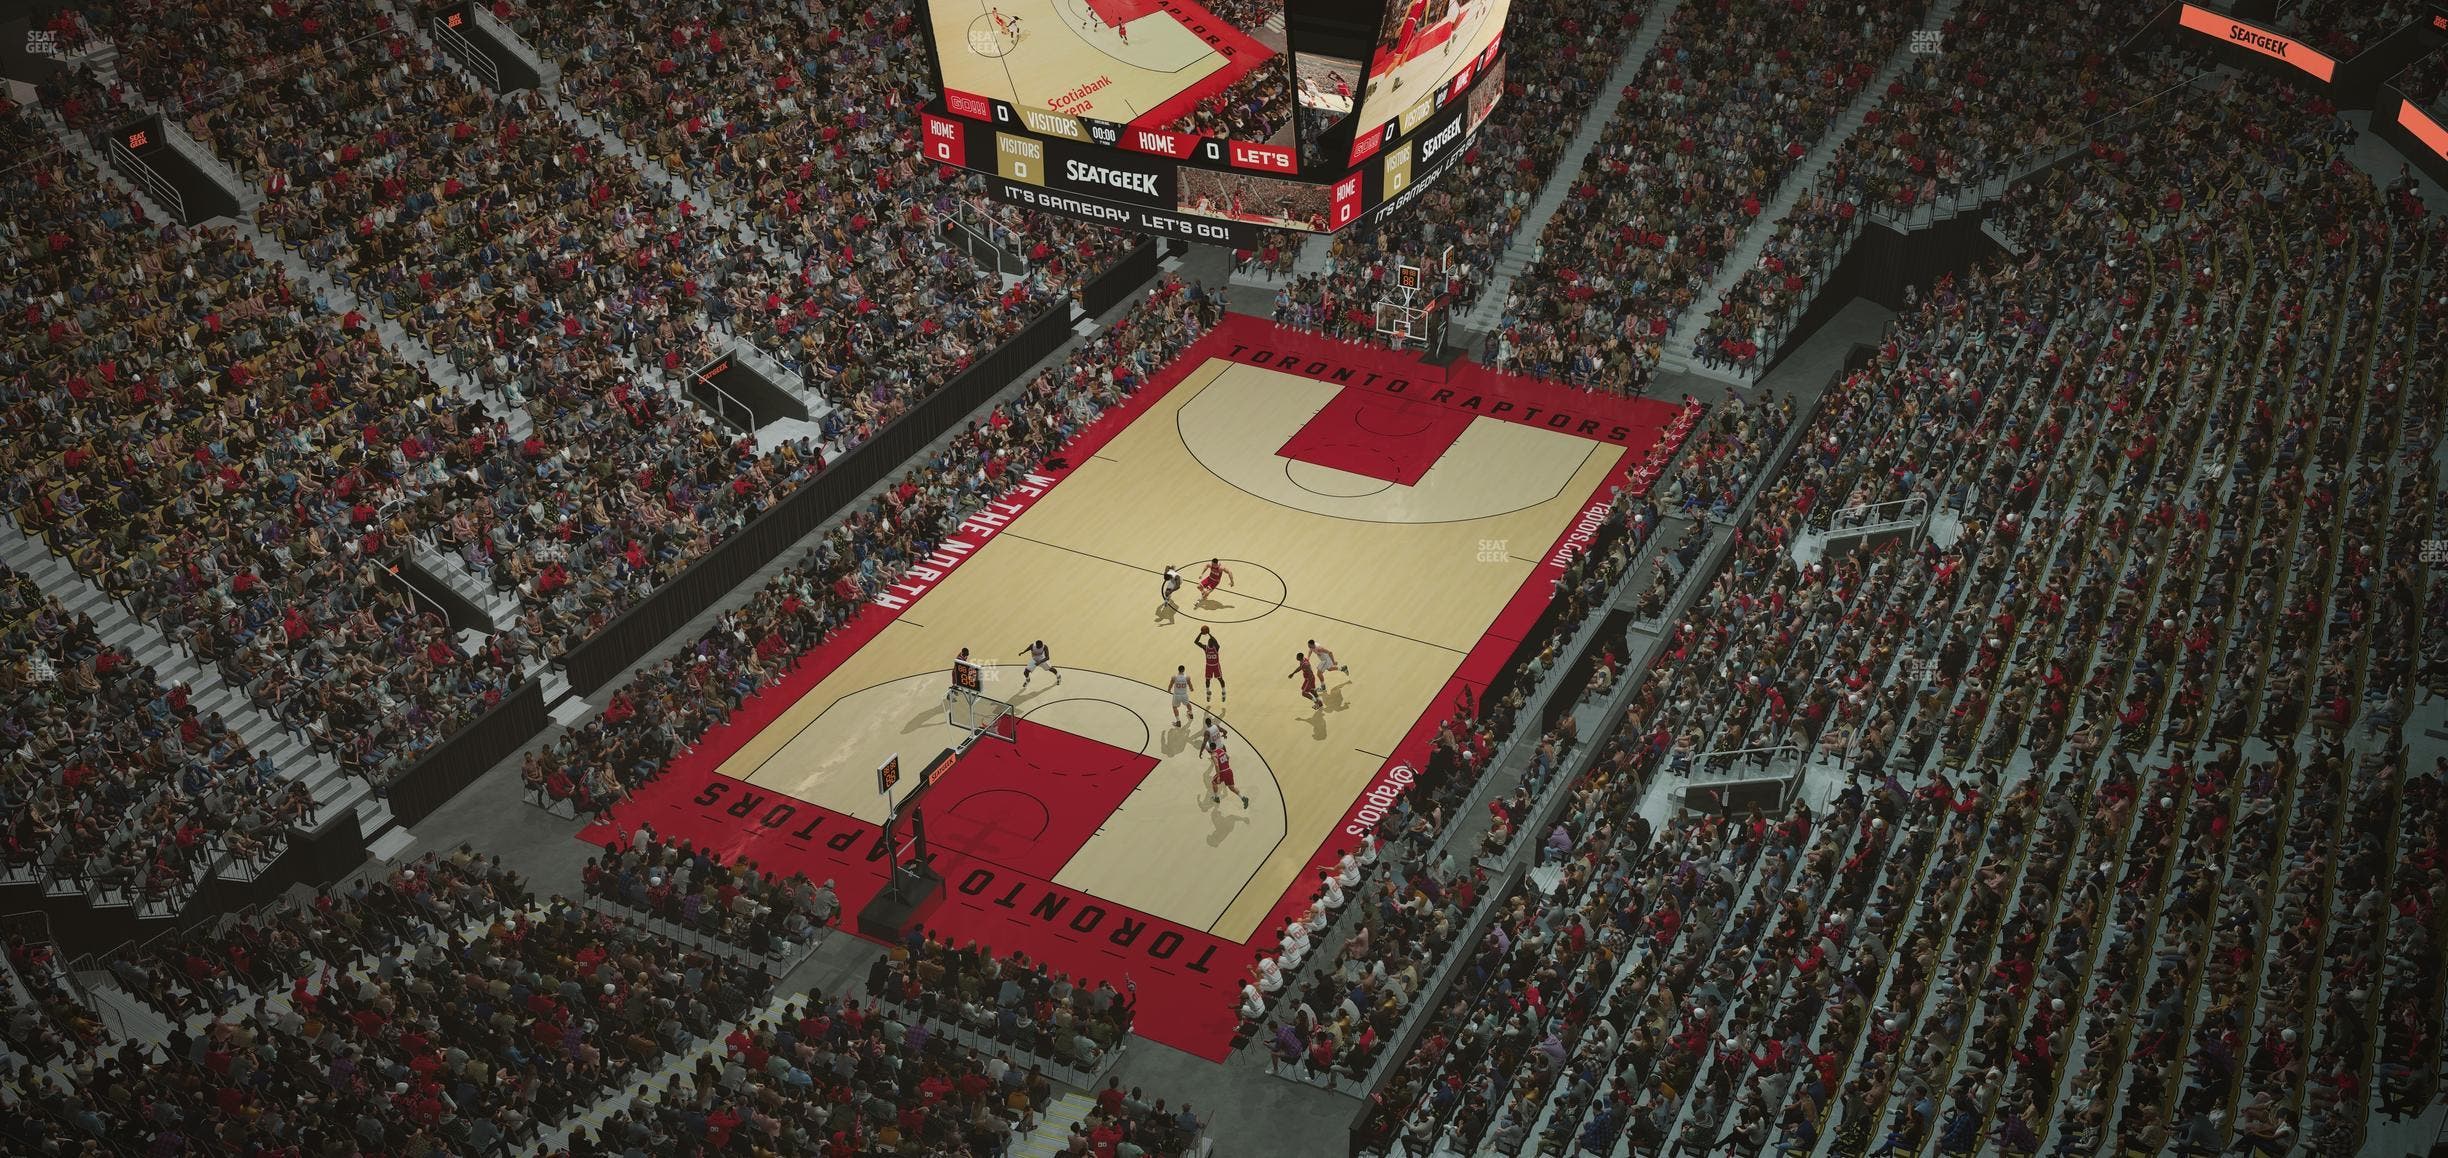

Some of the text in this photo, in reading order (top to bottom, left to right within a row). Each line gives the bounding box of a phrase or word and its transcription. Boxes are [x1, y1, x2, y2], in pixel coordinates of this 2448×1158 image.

[2230, 25, 2288, 57] SEATGEEK
[1048, 75, 1112, 112] Scotiabank
[997, 105, 1009, 122] 0
[1027, 110, 1078, 137] VISITORS
[930, 120, 955, 140] HOME
[1092, 126, 1116, 142] 00:00
[1139, 131, 1176, 154] HOME
[1385, 122, 1395, 141] 0
[1422, 112, 1462, 163] SEATGEEK
[938, 142, 950, 159] 0
[999, 137, 1040, 160] VISITORS
[1207, 142, 1220, 160] 0
[1236, 147, 1289, 168] LET'S
[1014, 161, 1027, 178] 0
[1066, 159, 1159, 197] SEATGEEK
[1393, 173, 1402, 190] 0
[1336, 178, 1356, 203] HOME
[1374, 201, 1396, 225] IT'S
[1395, 165, 1443, 209] GAMEDAY
[1004, 185, 1230, 241] IT'S GAMEDAY LET'S GO!
[1340, 203, 1351, 221] 0
[1229, 344, 1631, 442] TORONTO RAPTORS
[873, 473, 1057, 610] WE THE NORTH
[1550, 502, 1612, 568] raptors.com
[1346, 764, 1418, 839] @raptors
[694, 782, 938, 864] APTORS
[958, 868, 1219, 974] TORONTO
